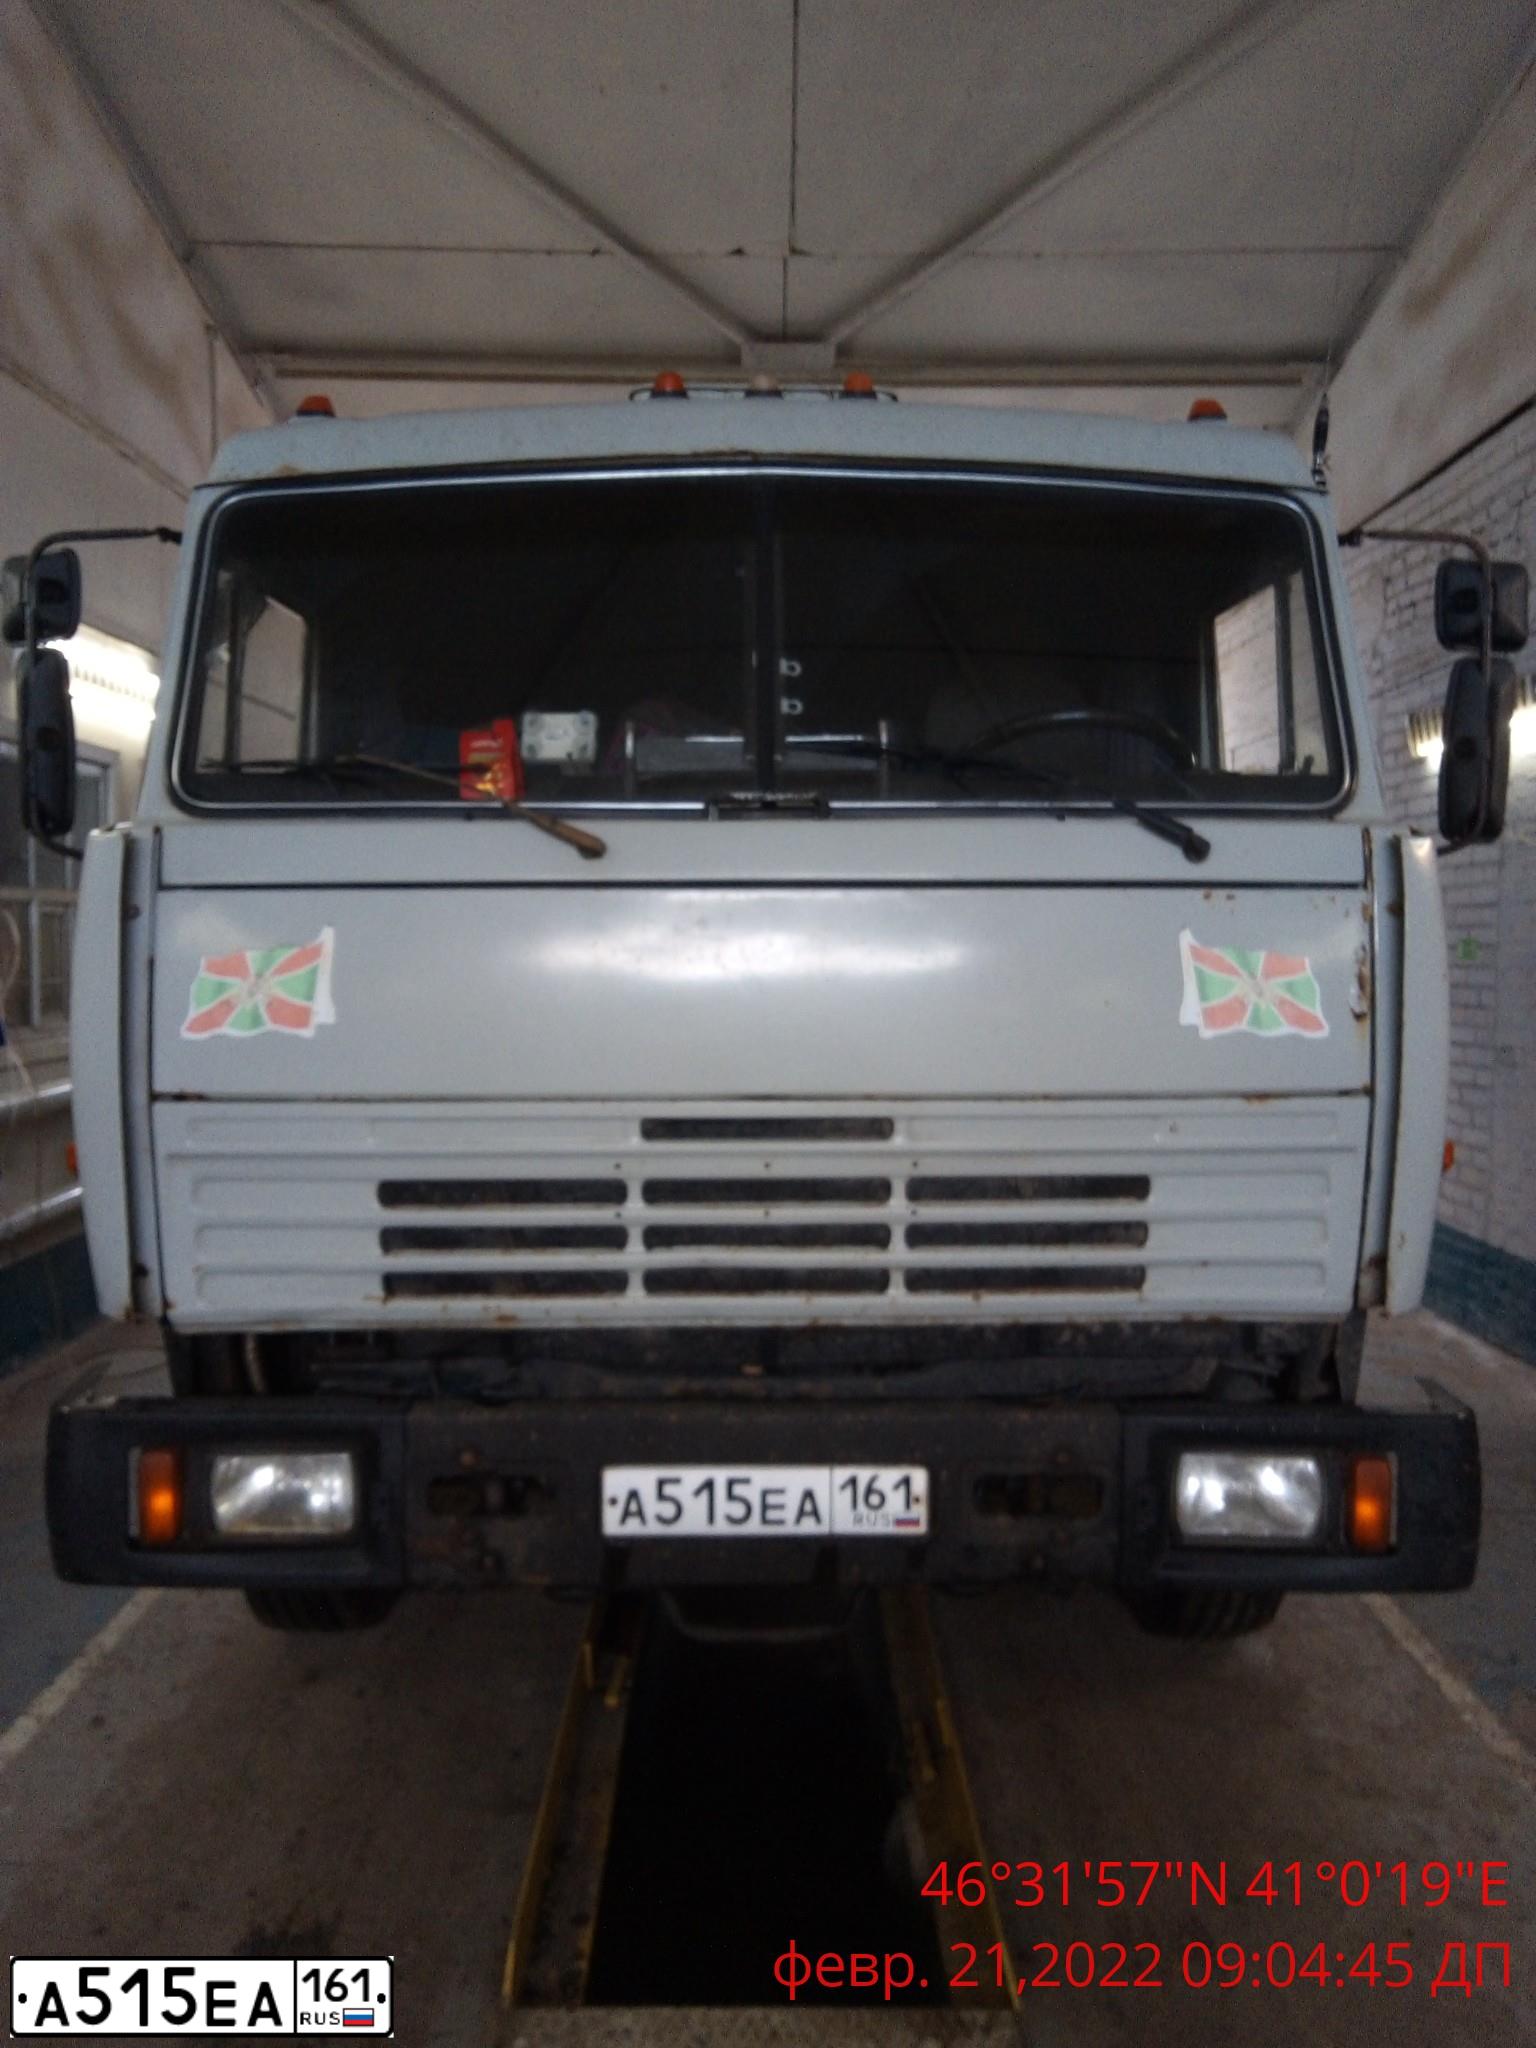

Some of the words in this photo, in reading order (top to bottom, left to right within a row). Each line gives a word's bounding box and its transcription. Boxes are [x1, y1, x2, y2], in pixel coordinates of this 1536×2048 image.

[619, 1477, 822, 1526] А515ЕА
[840, 1474, 913, 1511] 161
[851, 1510, 892, 1529] RUS
